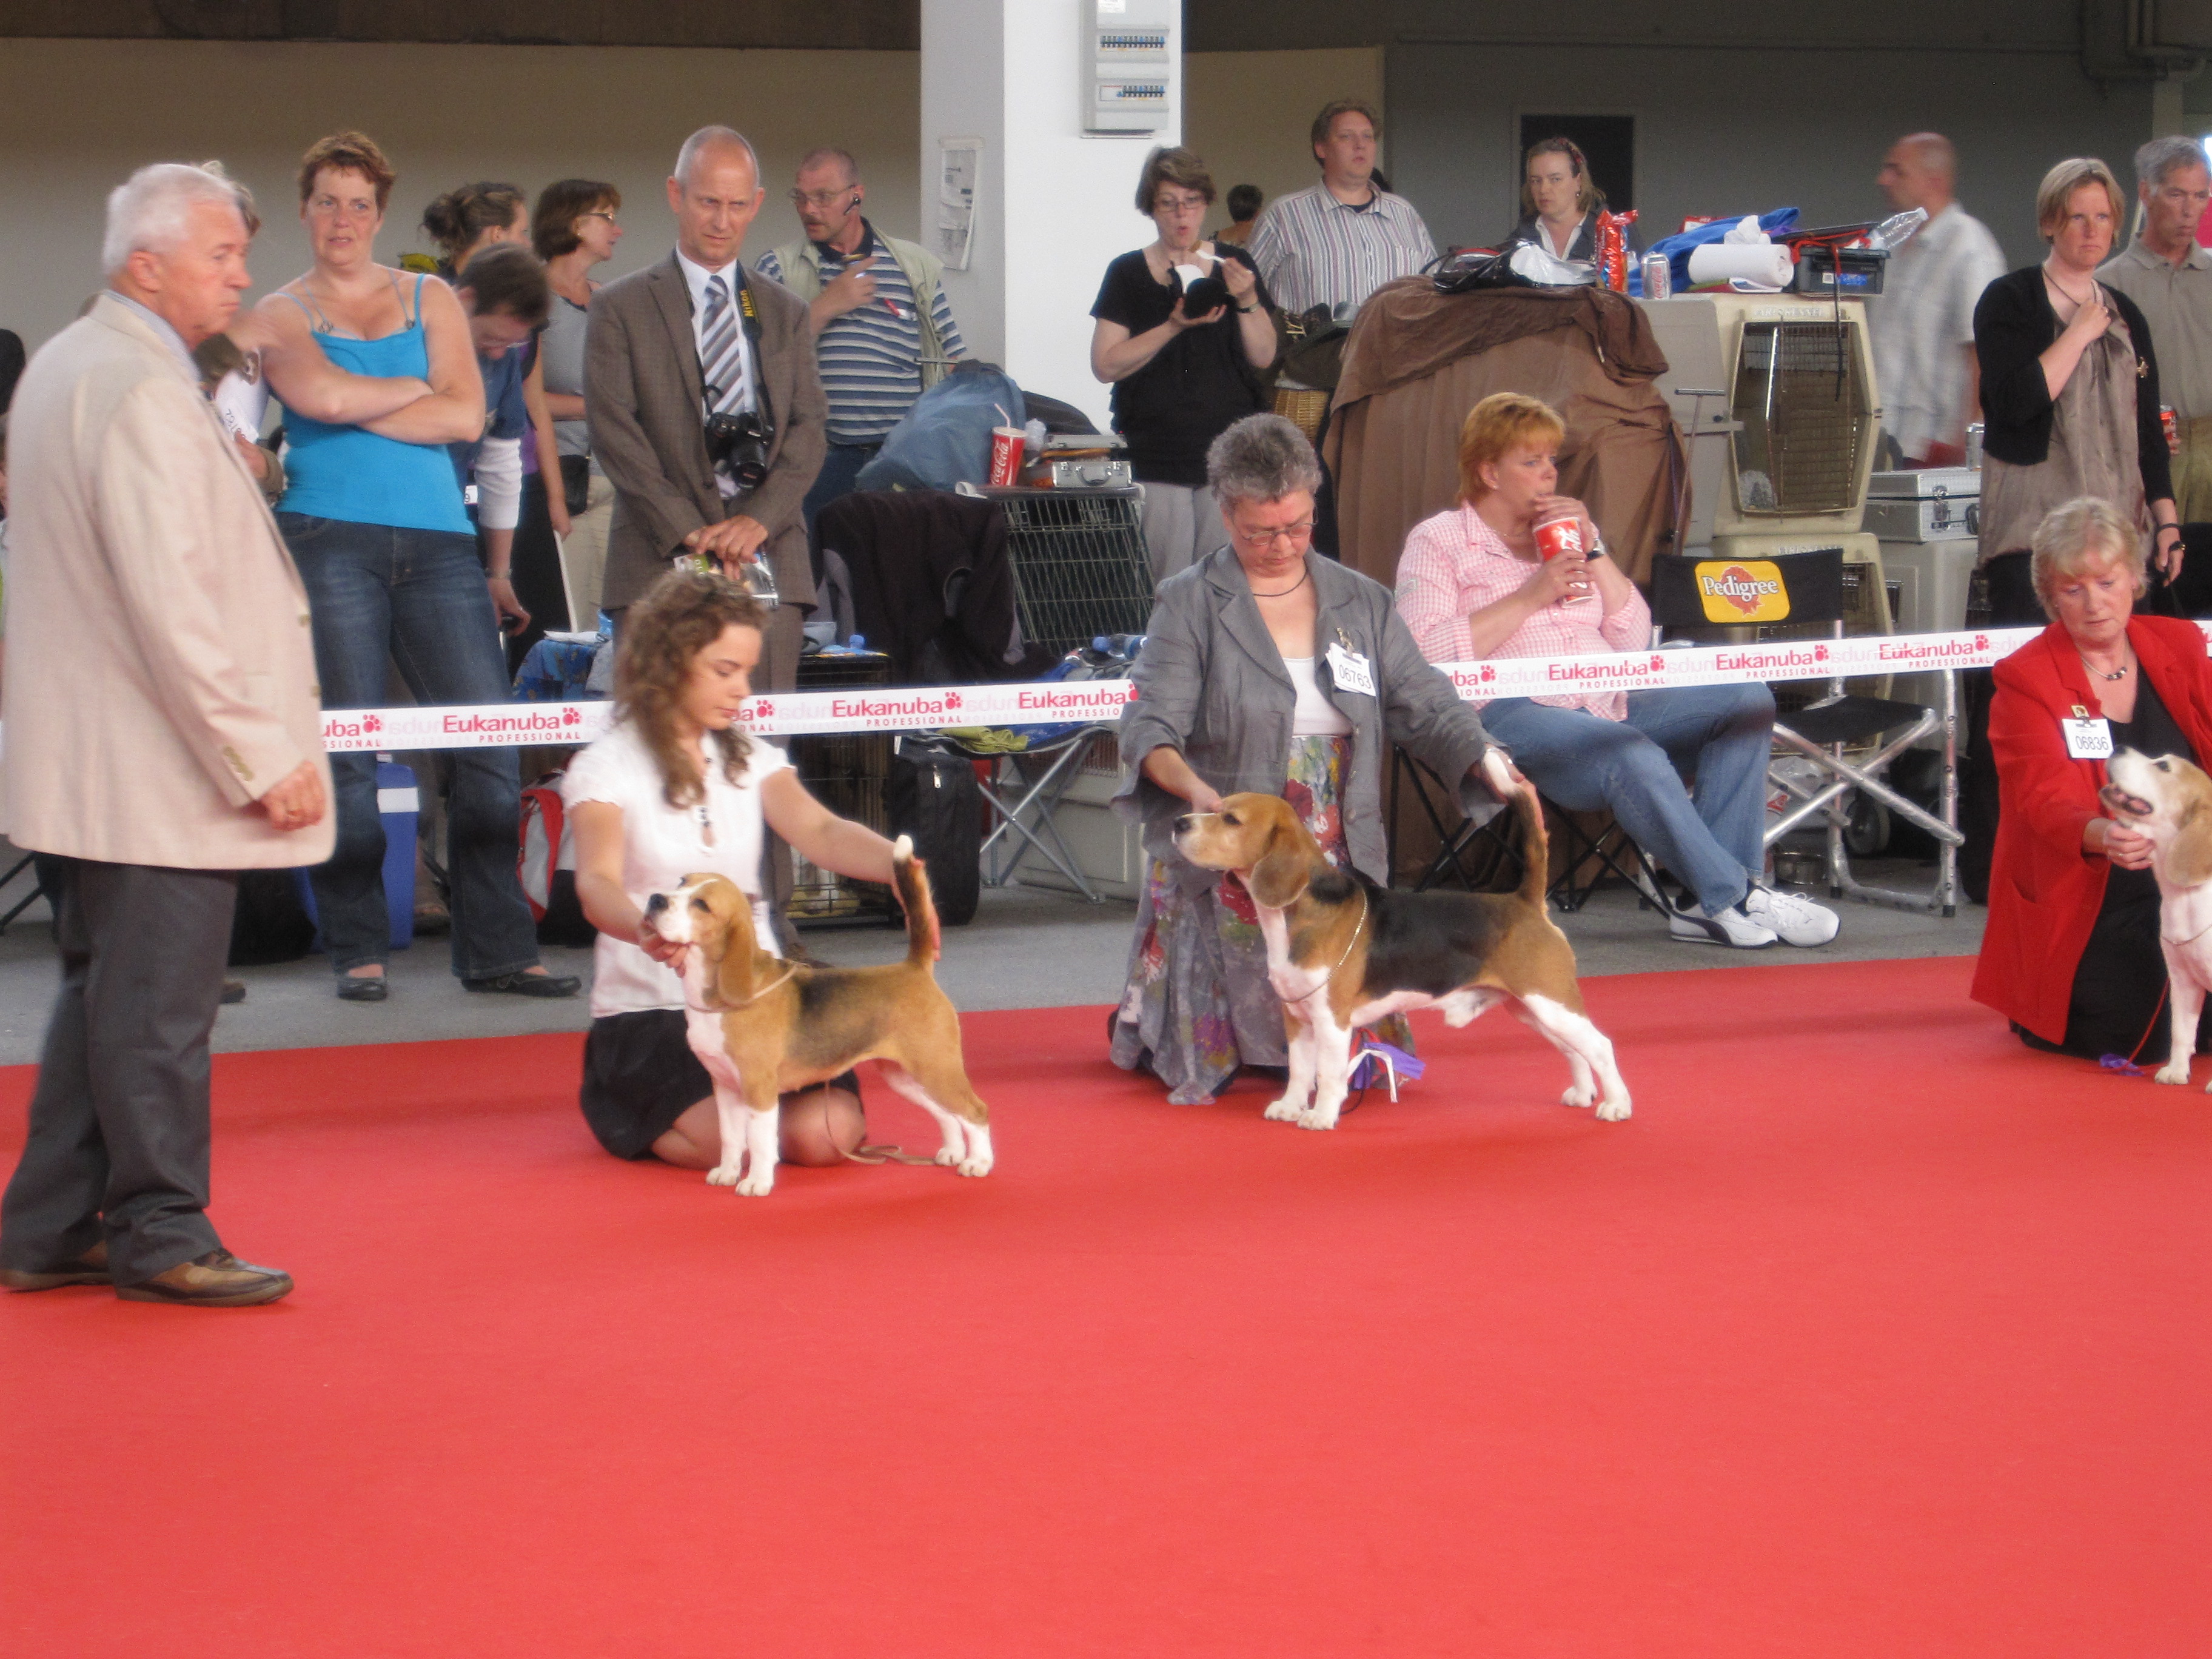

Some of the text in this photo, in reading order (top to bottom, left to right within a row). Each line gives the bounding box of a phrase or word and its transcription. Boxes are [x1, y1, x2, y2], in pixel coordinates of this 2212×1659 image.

[1701, 575, 1779, 602] Pedigree
[1715, 649, 1814, 671] Eukanuba
[1879, 640, 1975, 661] Eukanuba
[1548, 660, 1649, 682] Eukanuba
[1746, 666, 1831, 679] PROFESSIONAL
[1908, 656, 1991, 668] PROFESSIONAL
[1339, 665, 1372, 689] 06763
[1579, 677, 1666, 689] PROFESSIONAL
[832, 696, 943, 718] Eukanuba
[1018, 688, 1127, 709] Eukanuba
[443, 712, 560, 734] Eukanuba
[866, 715, 962, 727] PROFESSIONAL
[1051, 708, 1120, 718] PROFESSIO
[478, 731, 581, 743] PROFESSIONAL
[2075, 736, 2109, 750] 06836
